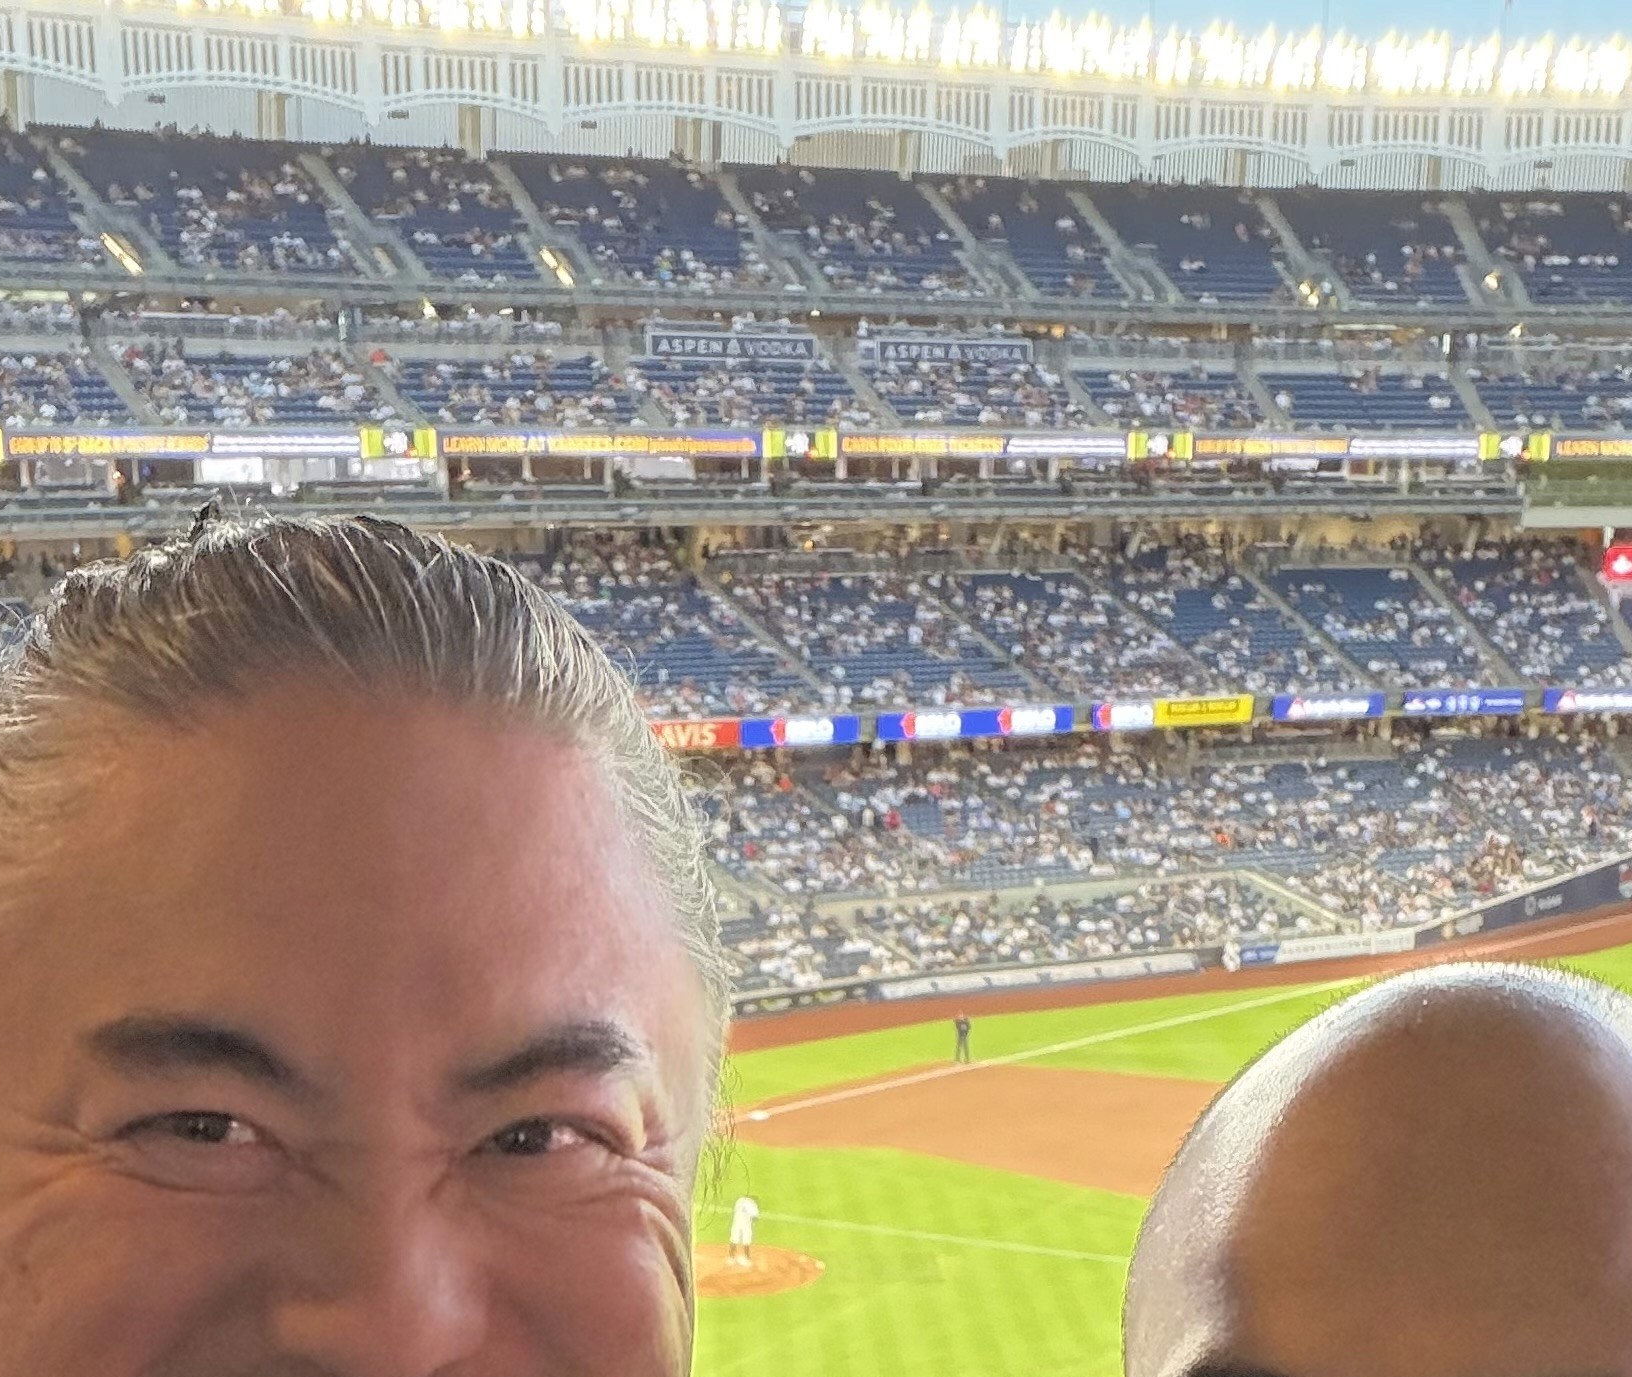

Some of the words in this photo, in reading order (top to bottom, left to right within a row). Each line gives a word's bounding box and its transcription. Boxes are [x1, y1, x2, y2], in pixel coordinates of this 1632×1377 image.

[657, 339, 722, 354] ASPEN
[745, 342, 809, 356] VODKA
[884, 345, 944, 359] ASPEN
[662, 722, 719, 748] AVIS
